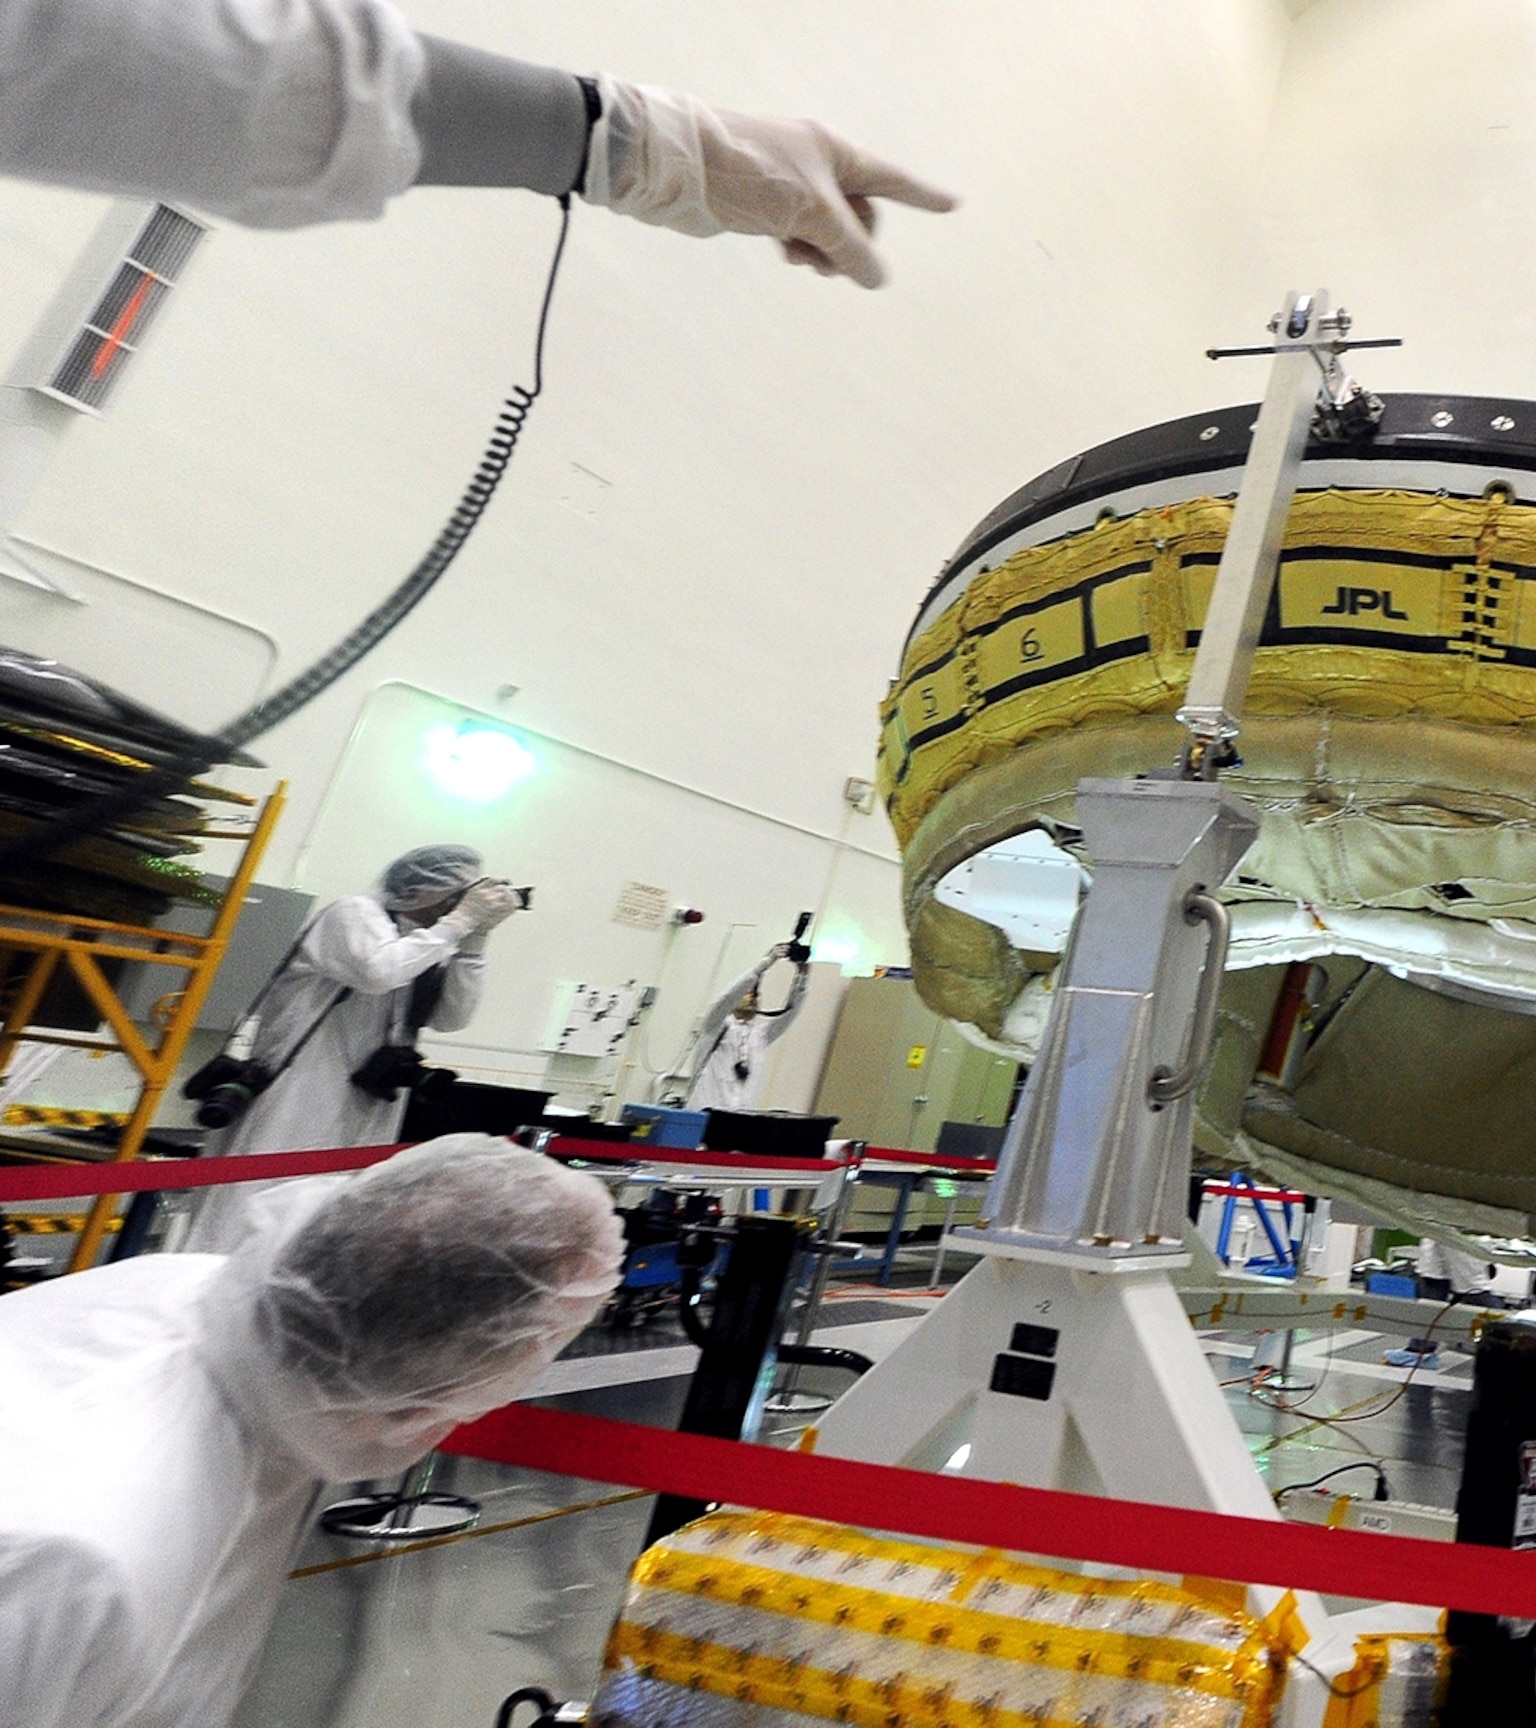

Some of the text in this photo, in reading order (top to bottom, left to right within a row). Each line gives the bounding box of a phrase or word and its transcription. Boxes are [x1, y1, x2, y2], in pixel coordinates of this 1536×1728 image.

[1321, 586, 1409, 621] JPL
[1020, 627, 1042, 658] 6
[921, 686, 939, 715] 5
